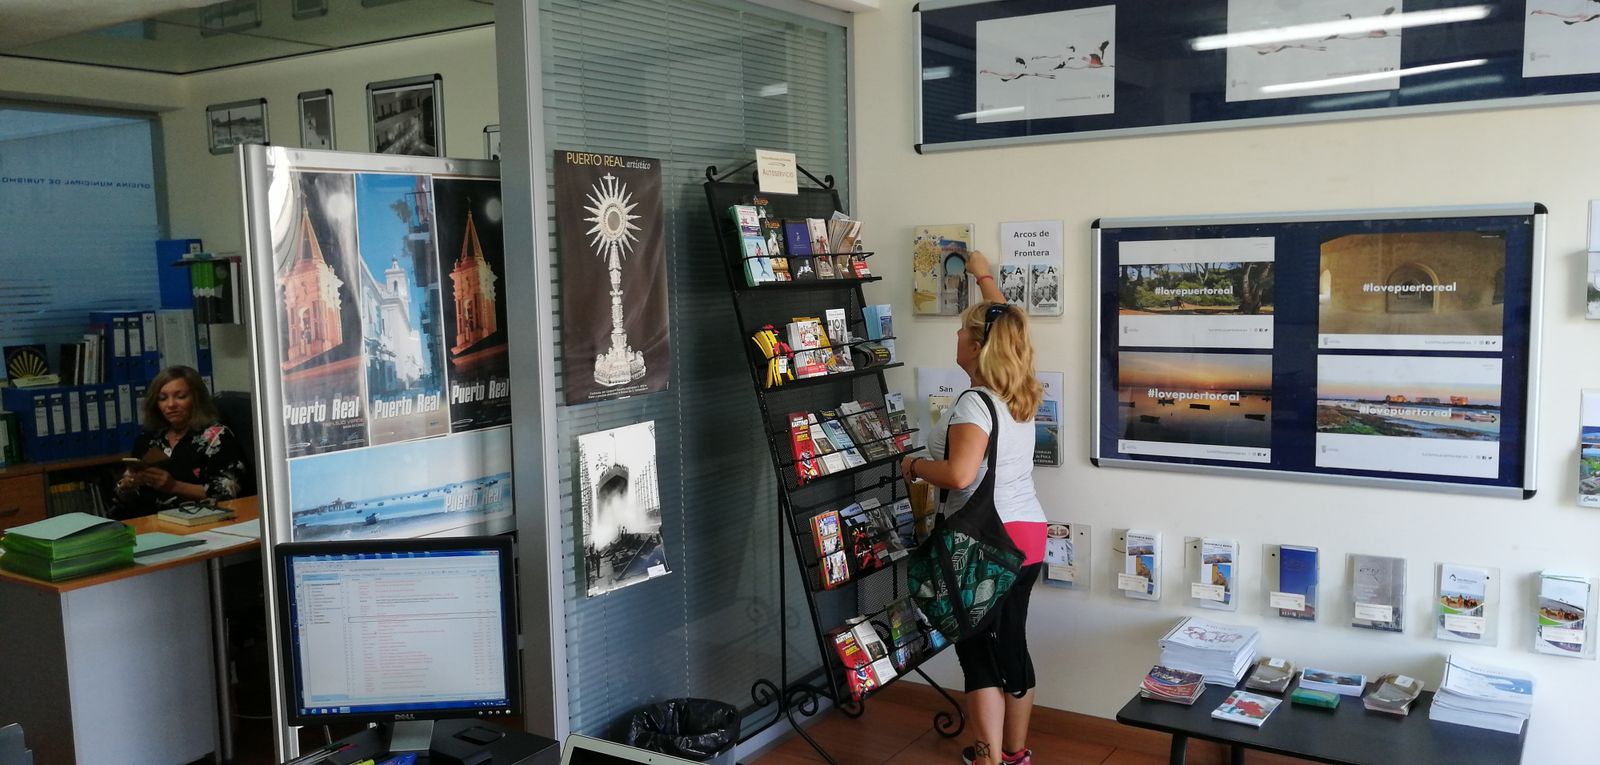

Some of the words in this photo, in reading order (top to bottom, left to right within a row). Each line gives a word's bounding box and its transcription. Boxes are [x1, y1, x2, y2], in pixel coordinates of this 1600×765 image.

[566, 152, 602, 166] PUERTO
[604, 155, 626, 168] REAL
[1013, 230, 1037, 239] Arcos
[1039, 230, 1050, 238] de
[1014, 249, 1050, 257] Frontera
[1154, 285, 1234, 297] #lovepuertoreal
[1362, 282, 1457, 294] #lovepuertoreal
[452, 382, 485, 405] Puerto
[488, 377, 510, 400] Real
[939, 385, 953, 393] San
[1147, 388, 1240, 401] #lovepuertoreal
[283, 399, 327, 426] Puerto
[331, 396, 360, 420] Real
[373, 396, 412, 420] Puerto
[416, 391, 440, 413] Real
[1359, 404, 1452, 419] #lovepuertoreal
[444, 491, 478, 513] Puerto
[481, 485, 502, 505] Real
